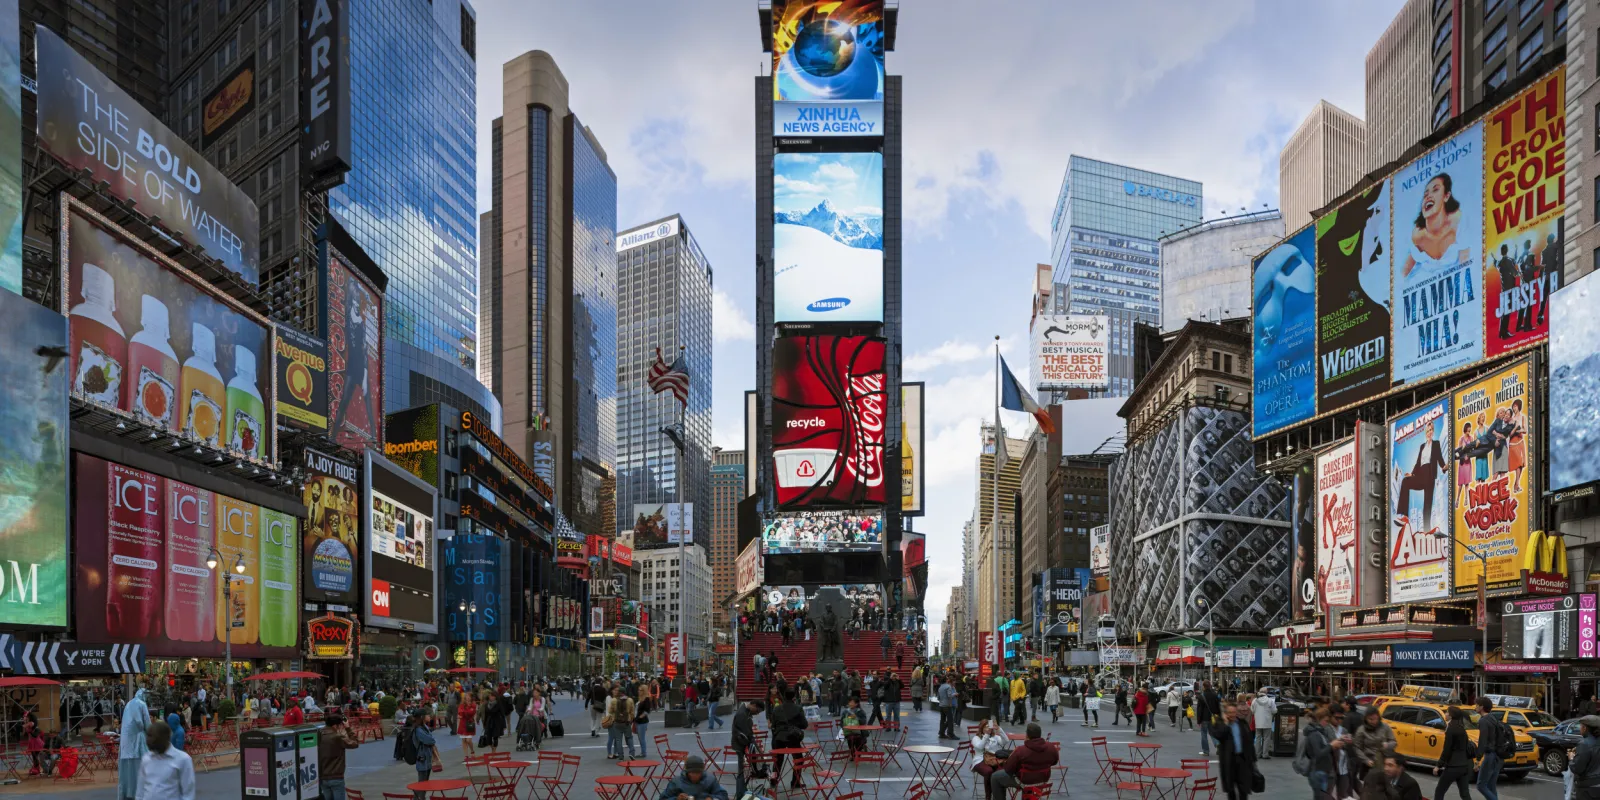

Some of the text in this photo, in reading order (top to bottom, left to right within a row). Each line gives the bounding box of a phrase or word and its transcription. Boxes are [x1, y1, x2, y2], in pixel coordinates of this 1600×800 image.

[797, 107, 861, 121] XINHUA
[1488, 76, 1566, 148] "TH
[783, 122, 875, 133] NEWS AGENCY
[76, 78, 130, 144] THE
[136, 128, 201, 195] BOLD
[310, 140, 331, 161] NYC
[1402, 141, 1472, 192] NEVER STOPS!
[77, 121, 243, 262] SIDE OF WATER
[1137, 185, 1196, 207] BARCLAYS
[620, 230, 656, 247] Allianz
[1403, 267, 1475, 329] MAMMA
[1495, 271, 1546, 319] JERSEY
[1066, 323, 1104, 332] MORMON
[1322, 313, 1350, 332] BIGGEST
[1322, 311, 1371, 340] BLOCKBUSTER"
[1417, 309, 1459, 358] MIA!
[275, 335, 325, 373] Avenue
[1039, 355, 1104, 365] "THE BEST
[1042, 365, 1104, 373] MUSICAL OF
[1276, 358, 1290, 371] The
[286, 360, 313, 406] Q
[1257, 360, 1311, 394] PHANTOM
[1501, 373, 1519, 390] Jessie
[1462, 388, 1486, 405] Matthew
[1495, 382, 1524, 405] MUELLER
[1264, 392, 1300, 416] OPERA
[1457, 396, 1491, 420] BRODERICK
[786, 417, 826, 429] recycle
[1395, 403, 1444, 442] JANE LYNCH
[315, 457, 333, 475] JOY
[1323, 452, 1353, 477] CAUSE FOR
[115, 465, 156, 482] SPARKLING
[1319, 465, 1355, 491] CELEBRATION
[115, 475, 158, 516] ICE
[173, 483, 209, 497] SPARKLING
[1469, 476, 1511, 509] NICE
[172, 491, 210, 528] ICE
[1368, 434, 1381, 569] PALACE
[222, 505, 254, 538] ICE
[1322, 492, 1353, 550] Kinky
[1464, 499, 1518, 531] WORK
[110, 520, 160, 536] Black Raspberry
[265, 517, 293, 548] ICE
[1335, 519, 1355, 537] Boots
[1475, 531, 1484, 540] You
[1484, 528, 1495, 540] Can
[1495, 525, 1506, 534] Get
[1390, 522, 1449, 570] Annie
[1478, 538, 1515, 551] Tony-Winning
[1496, 546, 1518, 557] Comedy
[115, 556, 155, 568] ZERO CALORIES
[314, 553, 351, 569] MOTOWN
[174, 565, 208, 576] ZERO CALORIES
[325, 573, 347, 584] BROADWAY
[0, 559, 42, 605] M
[1529, 577, 1569, 589] McDonald's
[372, 588, 390, 608] CNN
[773, 593, 779, 601] 5
[1056, 588, 1081, 601] HERO
[1387, 610, 1405, 622] Annie
[1413, 609, 1437, 622] Annie
[1522, 602, 1555, 613] COME INSIDE
[1342, 616, 1358, 627] Annie
[1363, 613, 1380, 624] Annie
[81, 649, 105, 657] WE'RE
[1293, 652, 1309, 664] Annie
[1315, 649, 1357, 658] BOX OFFICE HERE
[1370, 649, 1392, 664] Annie
[1396, 650, 1469, 660] MONEY EXCHANGE
[81, 658, 102, 666] OPEN
